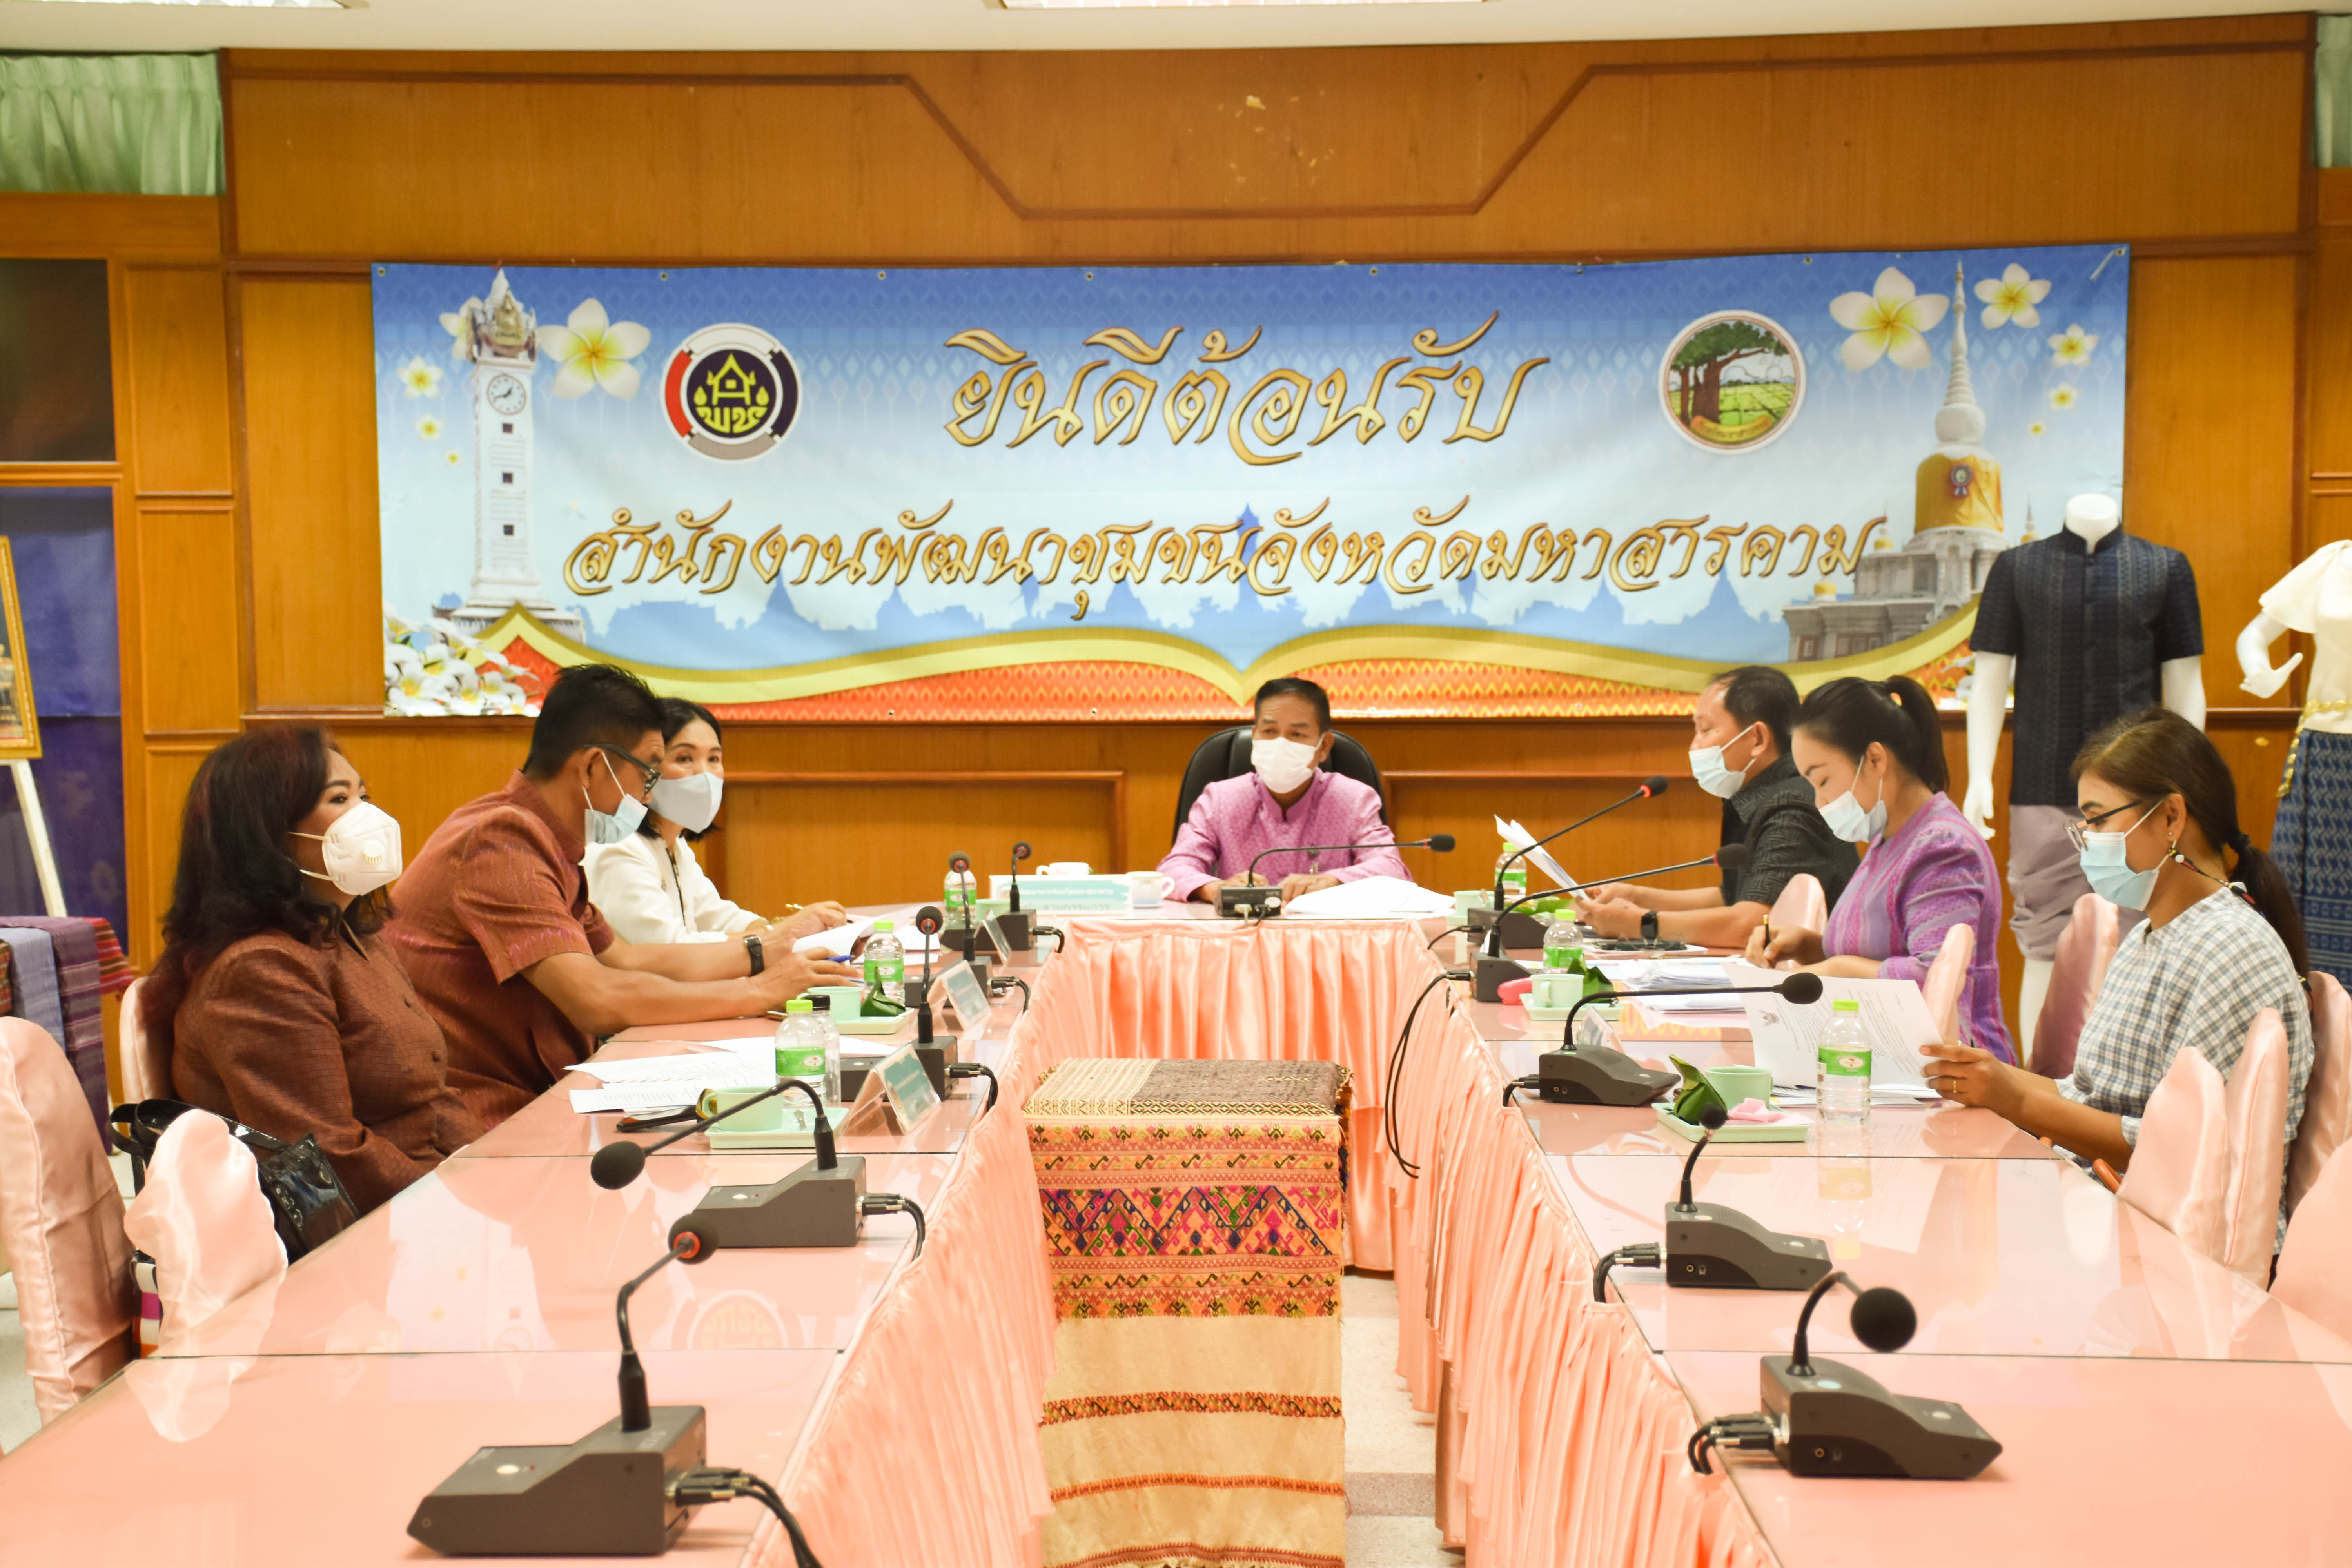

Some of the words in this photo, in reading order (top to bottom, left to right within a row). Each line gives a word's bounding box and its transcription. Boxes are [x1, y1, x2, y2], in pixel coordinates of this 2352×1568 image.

[944, 309, 1551, 466] ยินดีต้อนรับ
[563, 495, 1887, 620] สำนักงานพัฒนาชุมชนจังหวัดมหาสารคาม
